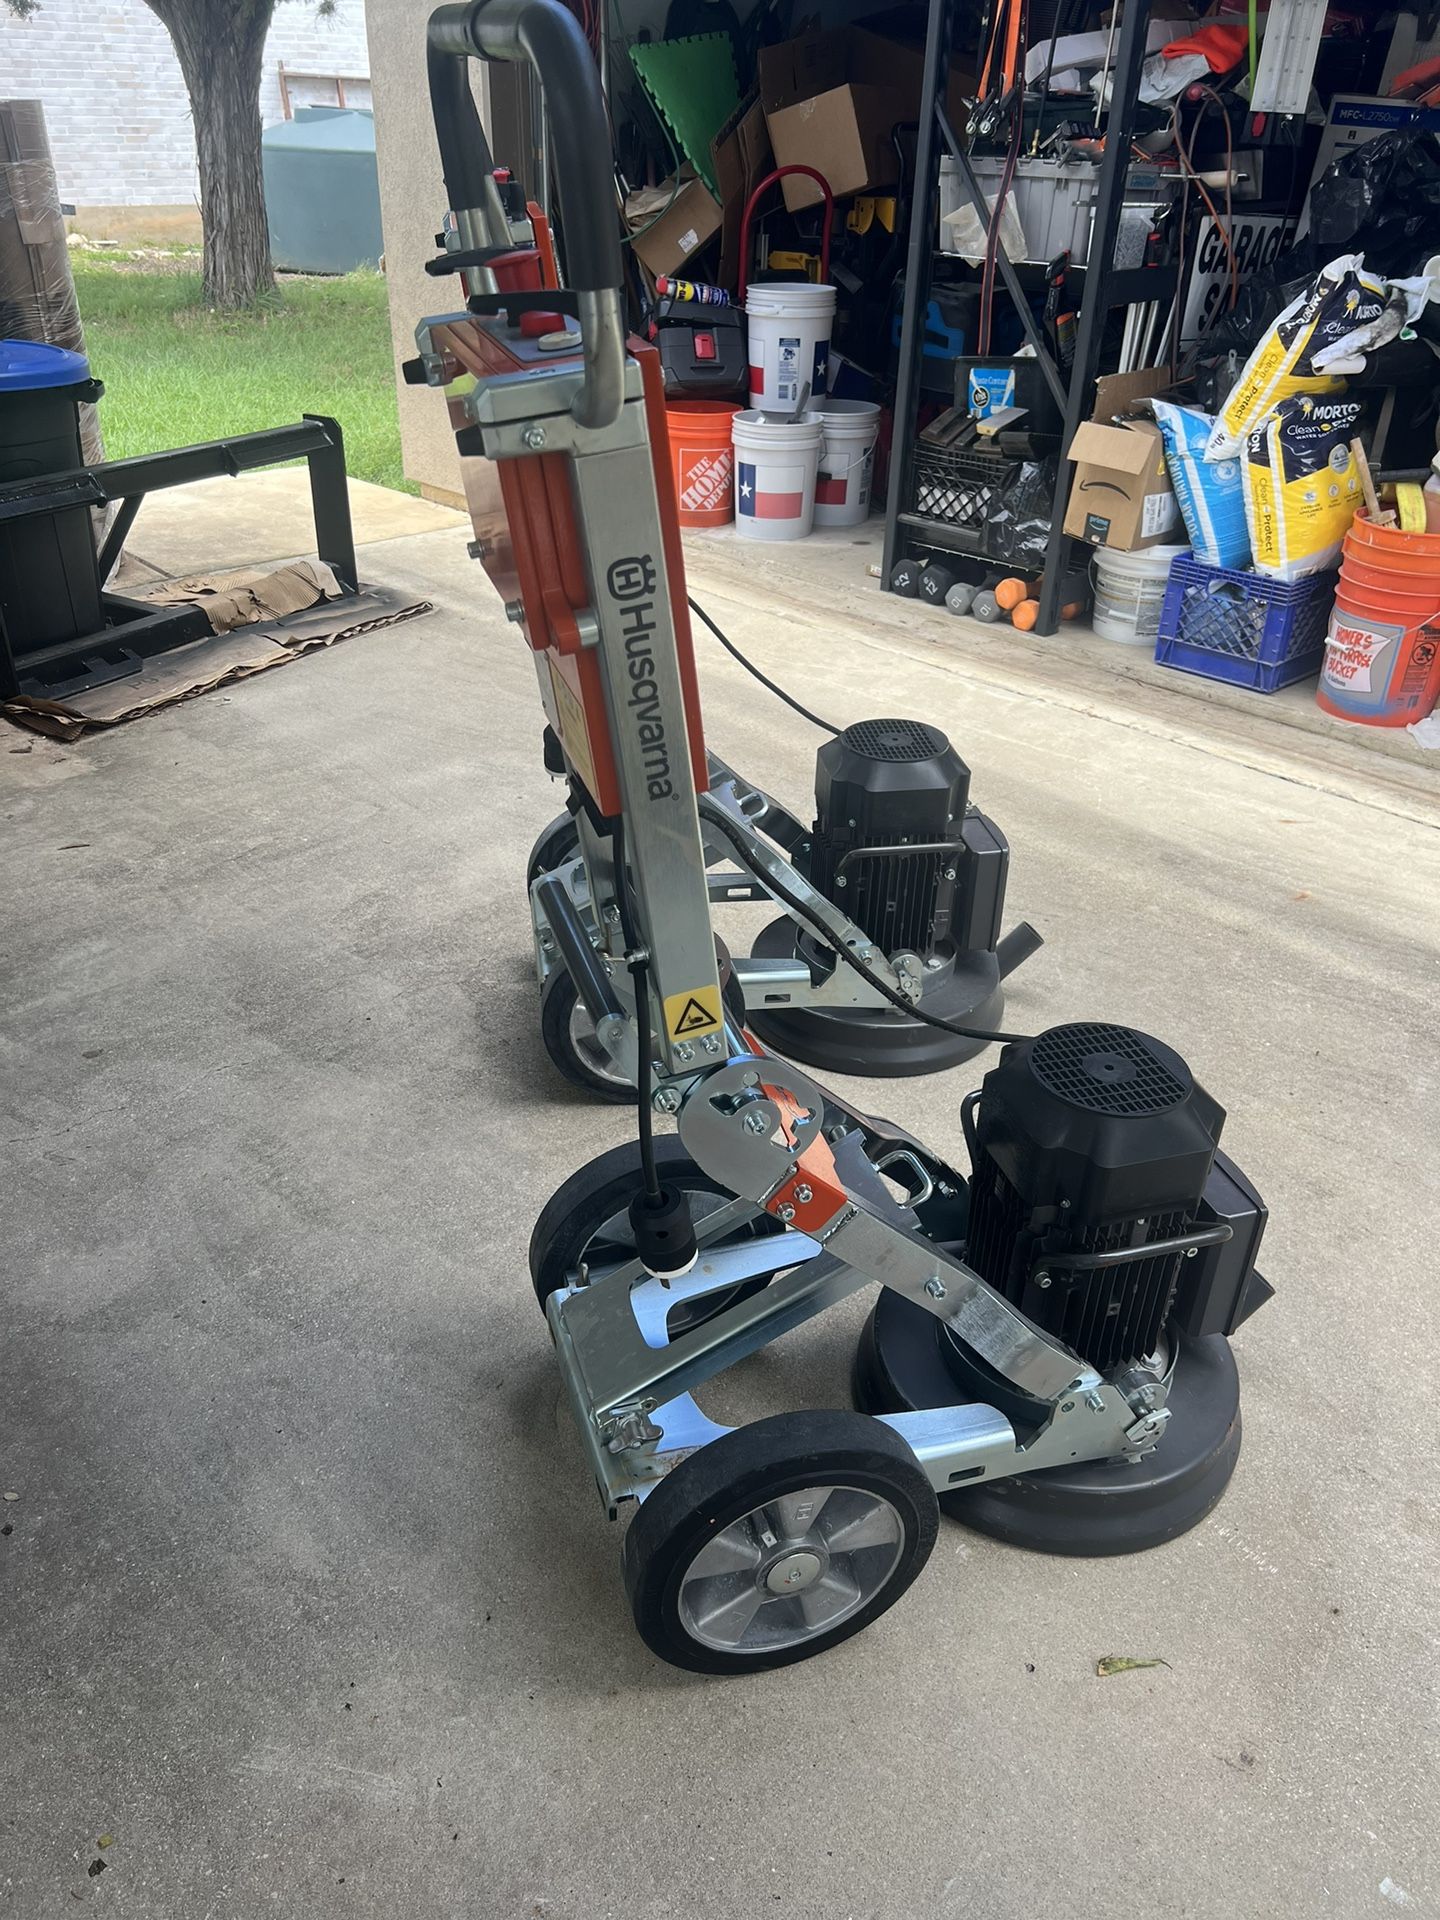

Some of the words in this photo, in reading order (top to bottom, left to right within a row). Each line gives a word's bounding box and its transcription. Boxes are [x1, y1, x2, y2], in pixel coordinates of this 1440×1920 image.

[1355, 304, 1383, 320] MORTO
[1234, 385, 1258, 420] Protect
[1312, 403, 1362, 420] MORTO
[1286, 424, 1320, 436] Clean
[686, 456, 712, 480] THE
[1263, 514, 1273, 552] Protect
[619, 601, 674, 801] Husqvarna
